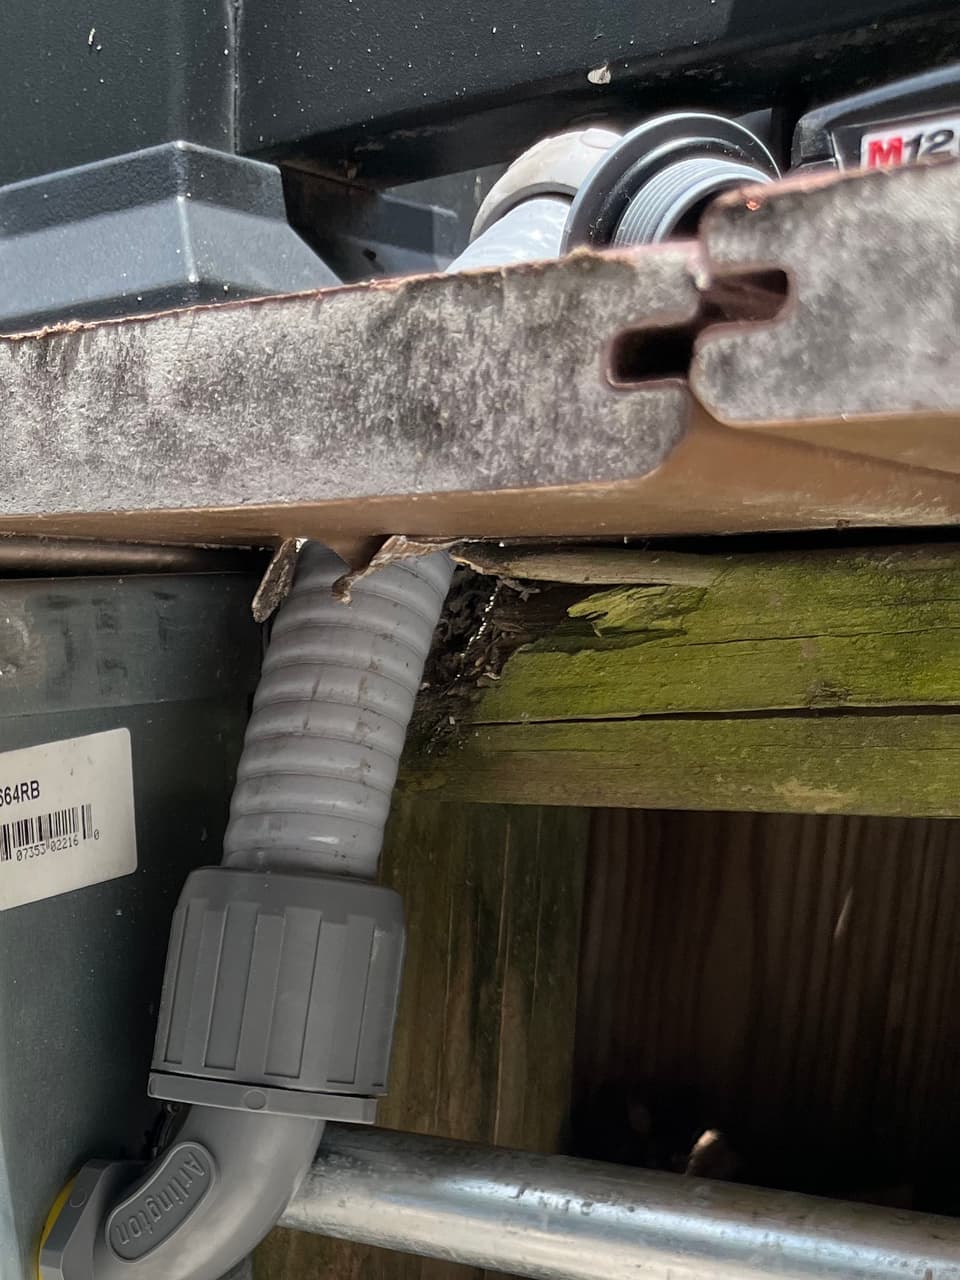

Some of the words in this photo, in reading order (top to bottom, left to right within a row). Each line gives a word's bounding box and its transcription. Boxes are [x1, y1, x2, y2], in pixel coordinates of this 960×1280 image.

[867, 129, 955, 170] M12
[16, 844, 47, 862] 07353
[50, 835, 80, 852] 02216
[93, 829, 101, 840] 0
[114, 1151, 205, 1245] Arlington
